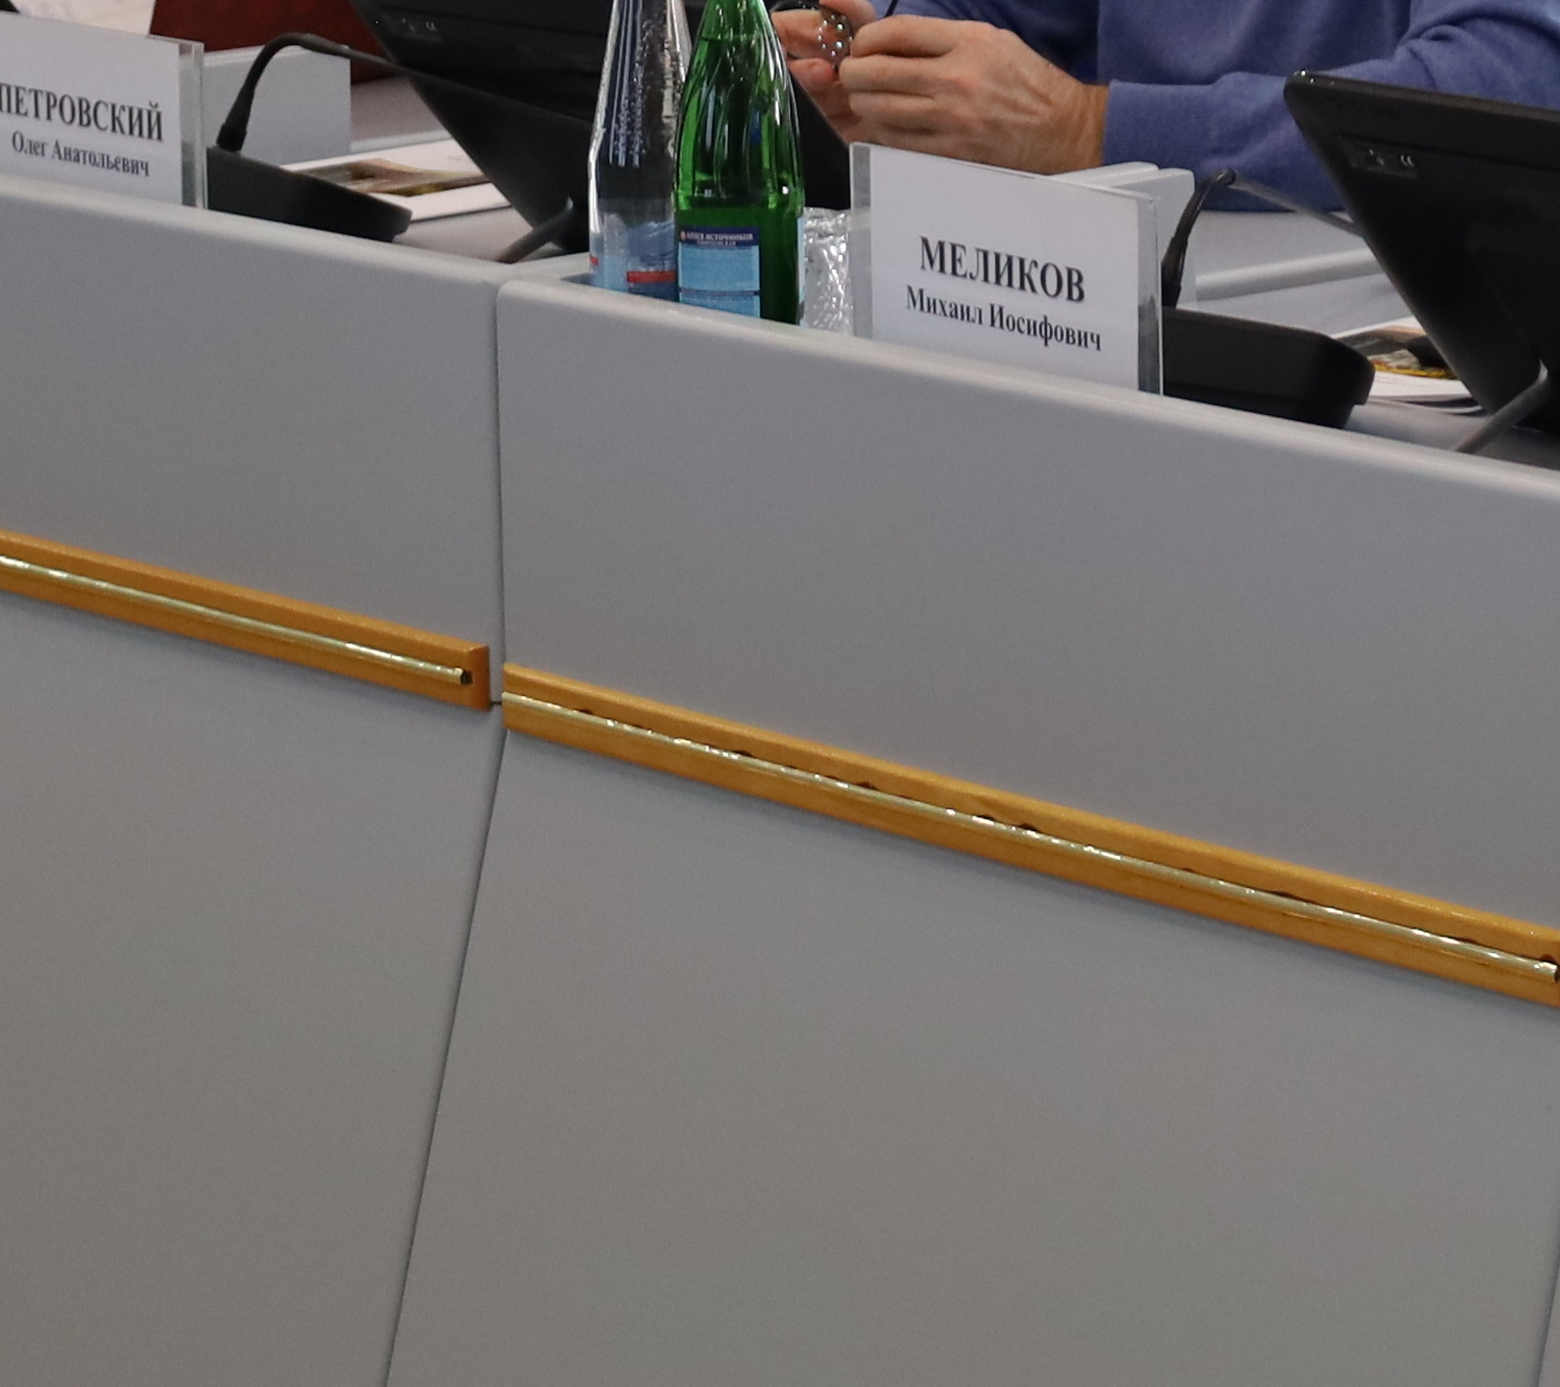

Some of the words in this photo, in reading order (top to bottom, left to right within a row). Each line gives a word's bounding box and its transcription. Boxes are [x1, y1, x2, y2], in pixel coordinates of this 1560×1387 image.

[12, 131, 47, 157] Олег
[52, 139, 150, 177] Анатольевич
[920, 236, 1085, 303] МЕЛИКОВ
[906, 284, 983, 326] Михаил
[989, 302, 1102, 351] Иосифович
